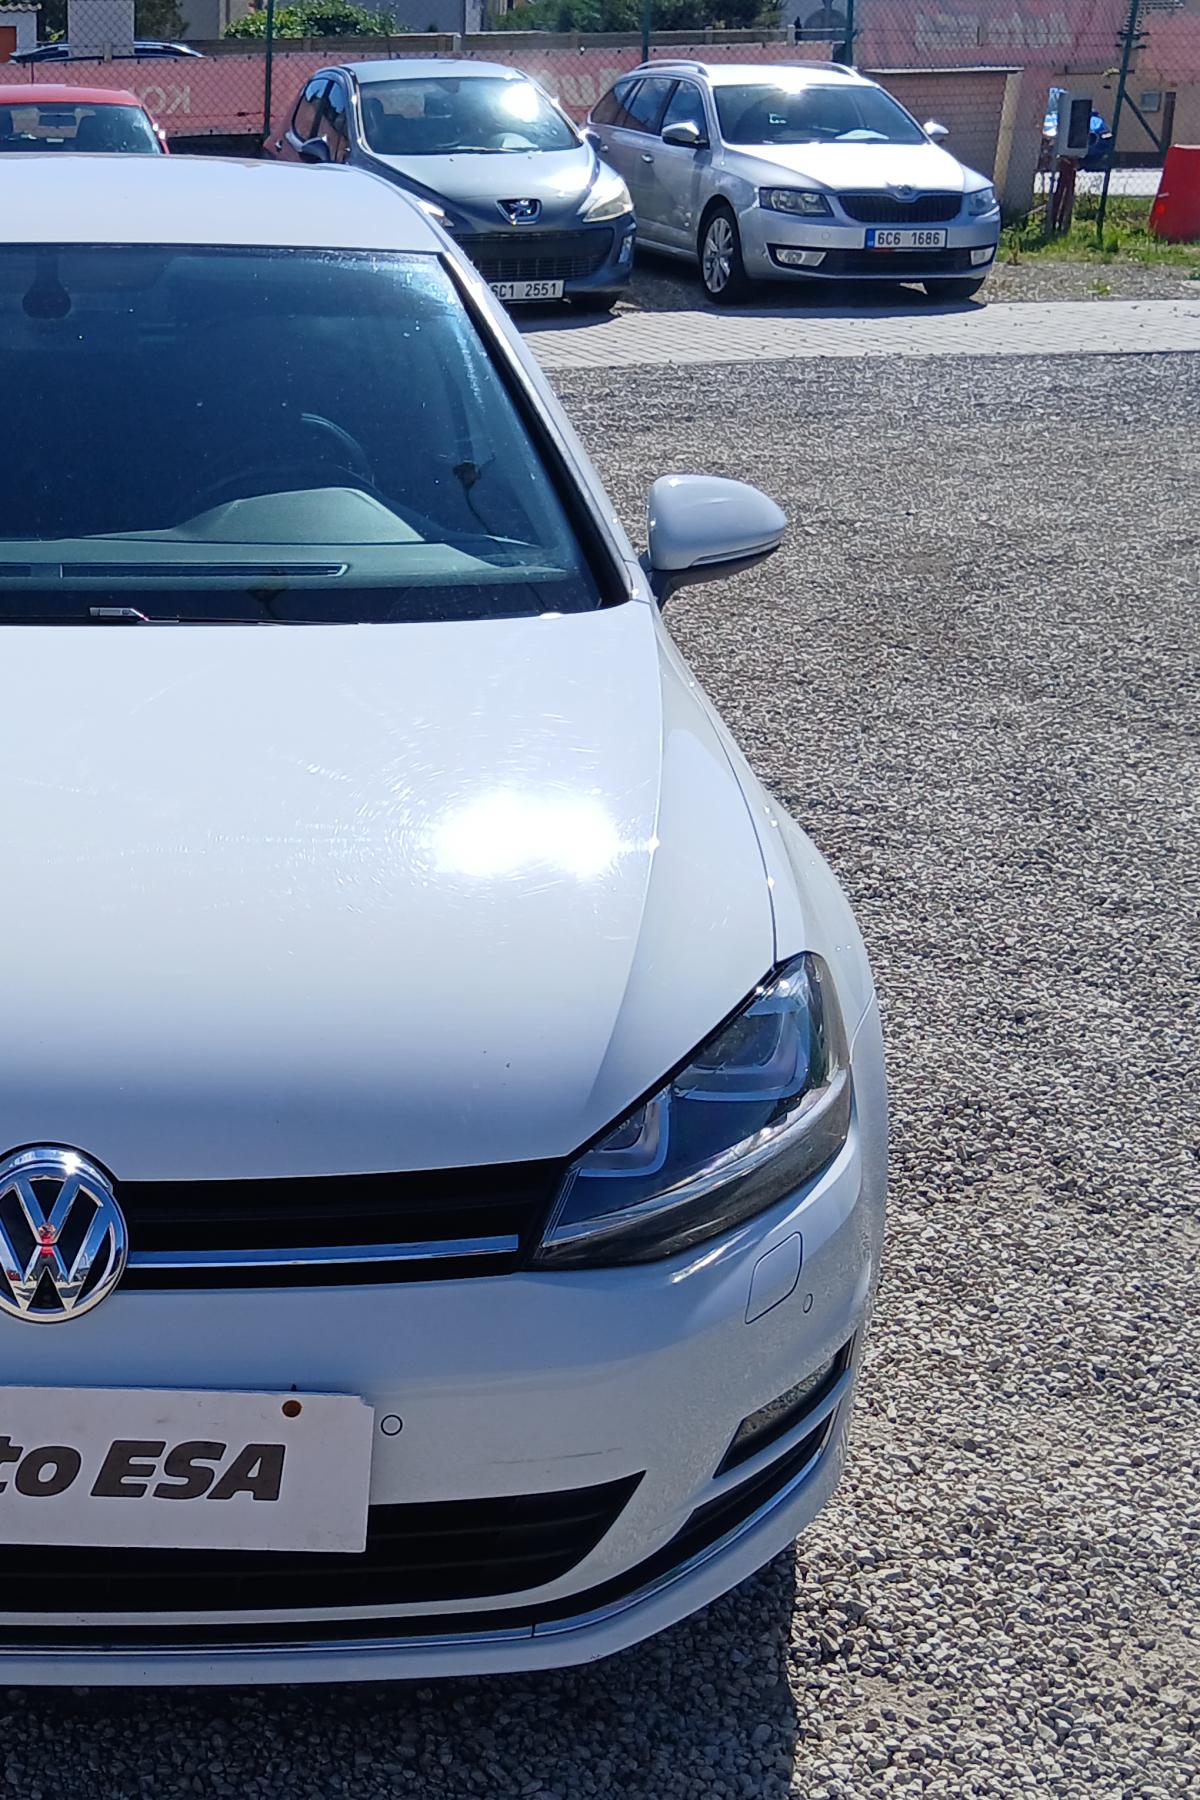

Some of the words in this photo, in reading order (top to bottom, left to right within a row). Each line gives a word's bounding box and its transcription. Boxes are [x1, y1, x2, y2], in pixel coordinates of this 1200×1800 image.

[877, 231, 902, 246] 6C6
[911, 231, 941, 246] 1686
[524, 282, 557, 297] 2551
[89, 1439, 287, 1502] ESA
